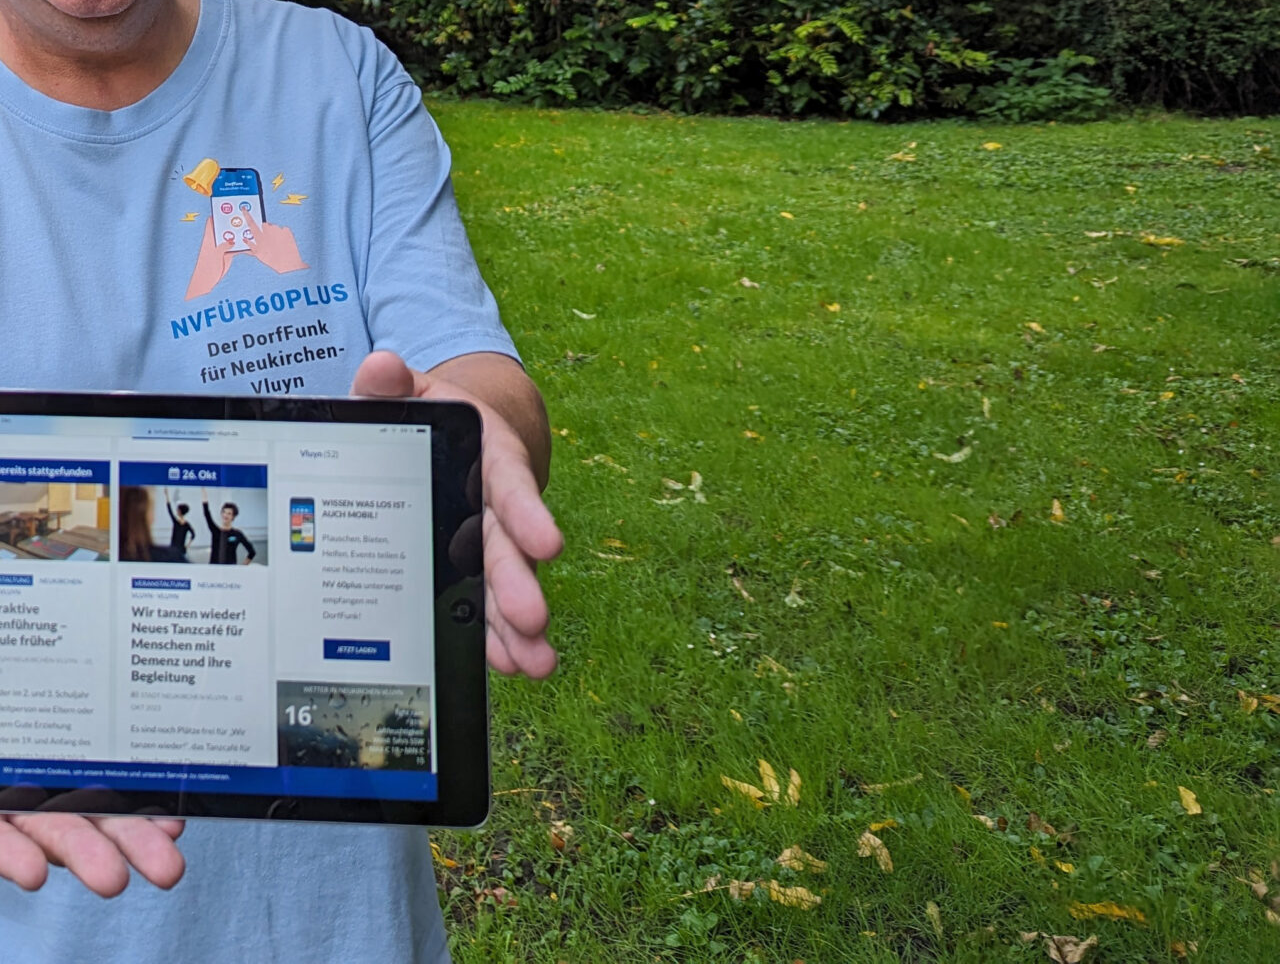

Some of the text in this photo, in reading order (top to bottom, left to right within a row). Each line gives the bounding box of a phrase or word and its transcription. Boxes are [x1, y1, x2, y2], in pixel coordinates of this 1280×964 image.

[170, 283, 349, 339] NVFÜR60PLUS
[207, 319, 329, 358] Der DorfFunk
[200, 346, 345, 384] für Neukirchen-
[250, 376, 305, 394] Vluyn
[300, 449, 322, 460] Vluyn
[28, 465, 93, 478] stattgefunden
[182, 469, 217, 480] 26. Okt
[322, 499, 353, 508] WISSEN
[356, 500, 375, 508] WAS
[376, 501, 392, 509] LOS
[393, 501, 406, 509] IST
[322, 510, 378, 519] AUCH MOBIL!
[132, 606, 246, 620] Wir tanzen wieder!
[131, 622, 244, 636] Neues Tanzcafé für
[131, 638, 215, 651] Menschen mit
[131, 654, 232, 668] Demenz und ihre
[131, 670, 195, 685] Begleitung
